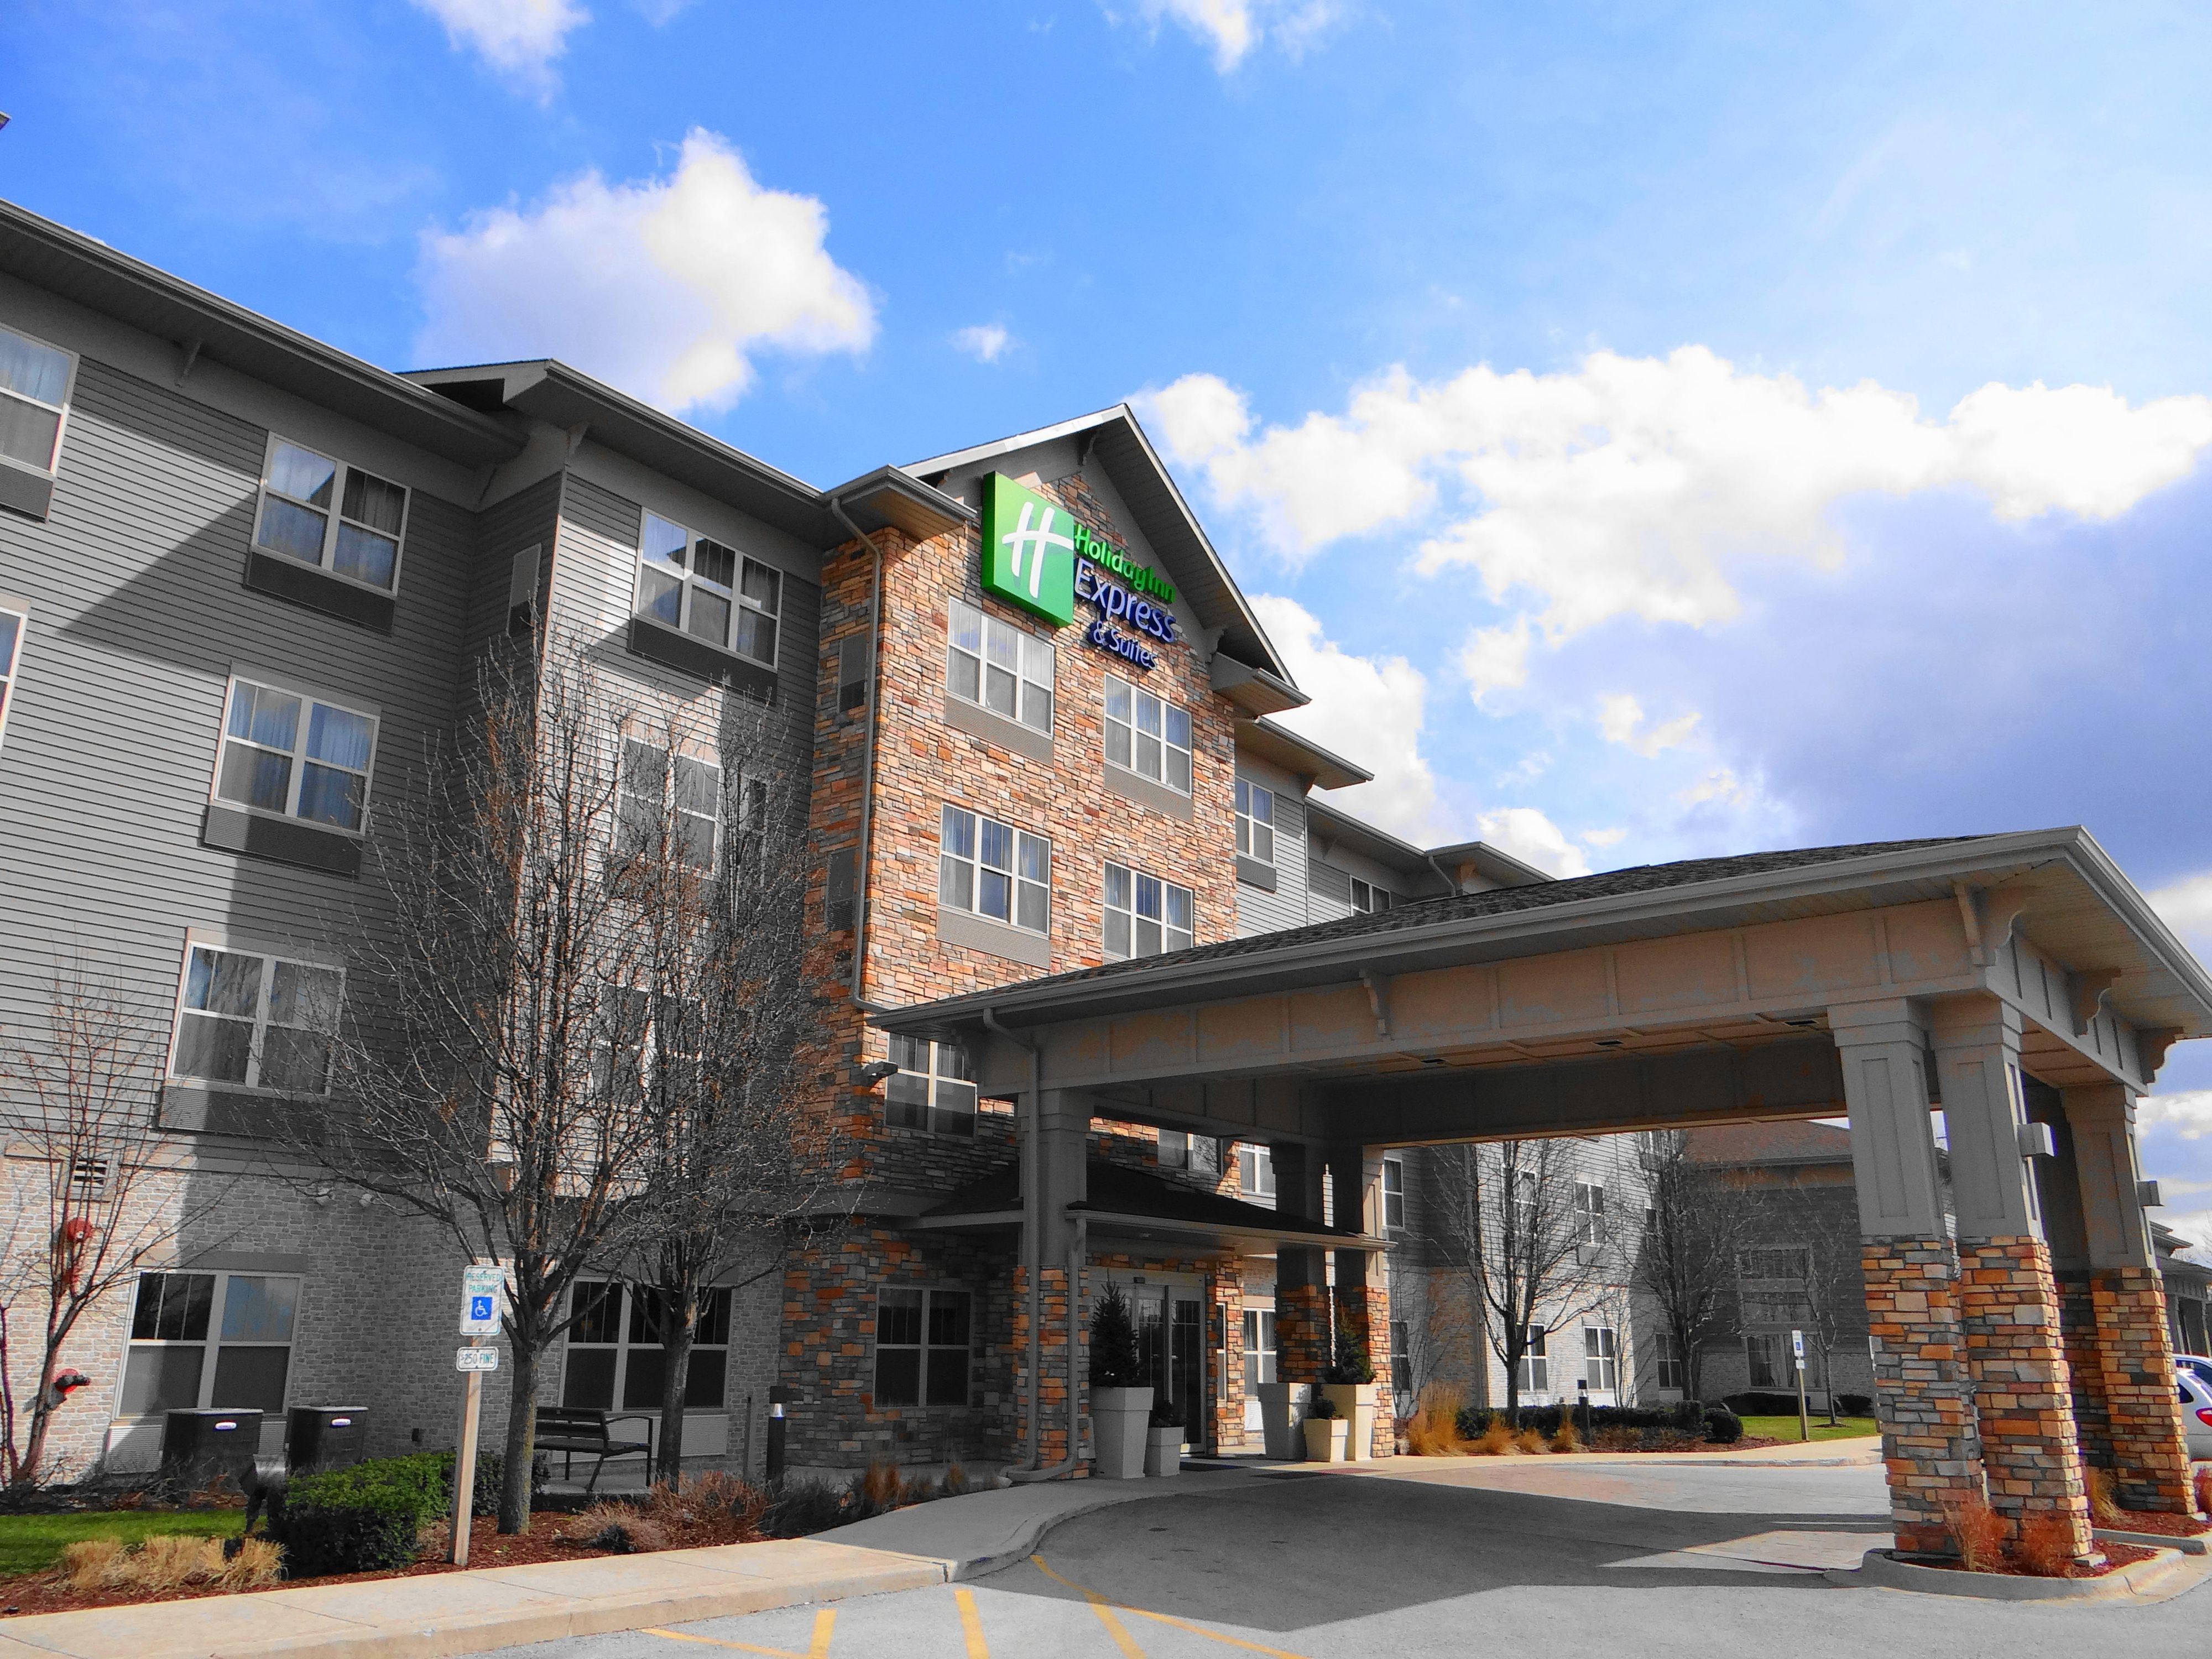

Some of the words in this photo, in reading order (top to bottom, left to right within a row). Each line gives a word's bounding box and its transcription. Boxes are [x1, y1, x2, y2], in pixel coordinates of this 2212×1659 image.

[1074, 524, 1146, 591] Holiday
[1147, 566, 1176, 603] Inn
[1074, 557, 1176, 643] Express
[1093, 620, 1107, 646] &
[1109, 629, 1158, 671] Suites
[466, 1272, 502, 1282] RESERVED
[468, 1284, 497, 1293] PARKING
[461, 1353, 477, 1364] $250
[479, 1353, 494, 1364] FINE
